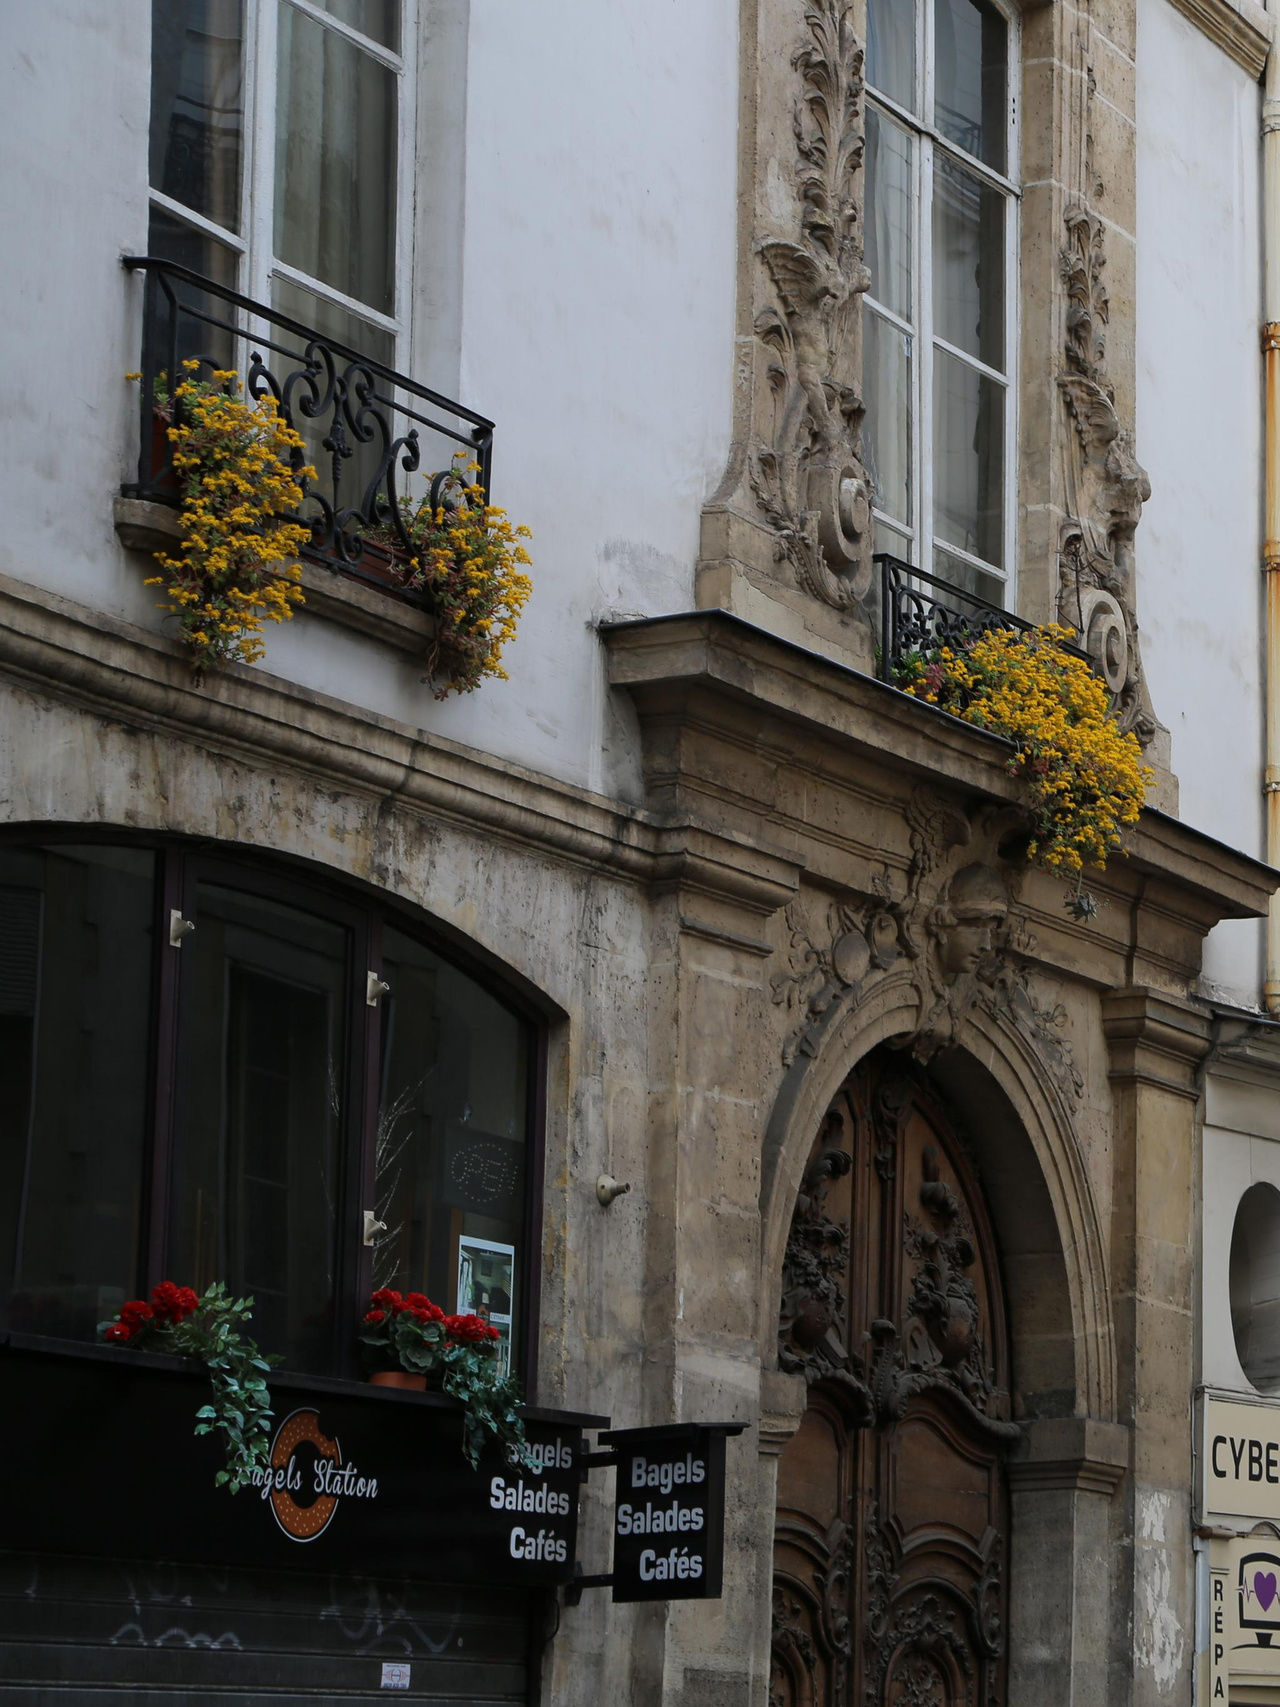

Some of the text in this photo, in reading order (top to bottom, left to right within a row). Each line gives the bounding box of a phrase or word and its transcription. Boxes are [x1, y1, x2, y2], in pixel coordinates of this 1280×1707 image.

[313, 1459, 379, 1499] Station
[631, 1452, 706, 1495] Bagels
[490, 1477, 570, 1516] Salades
[617, 1500, 704, 1536] Salades
[510, 1526, 567, 1563] Cafés
[639, 1547, 703, 1582] Cafés
